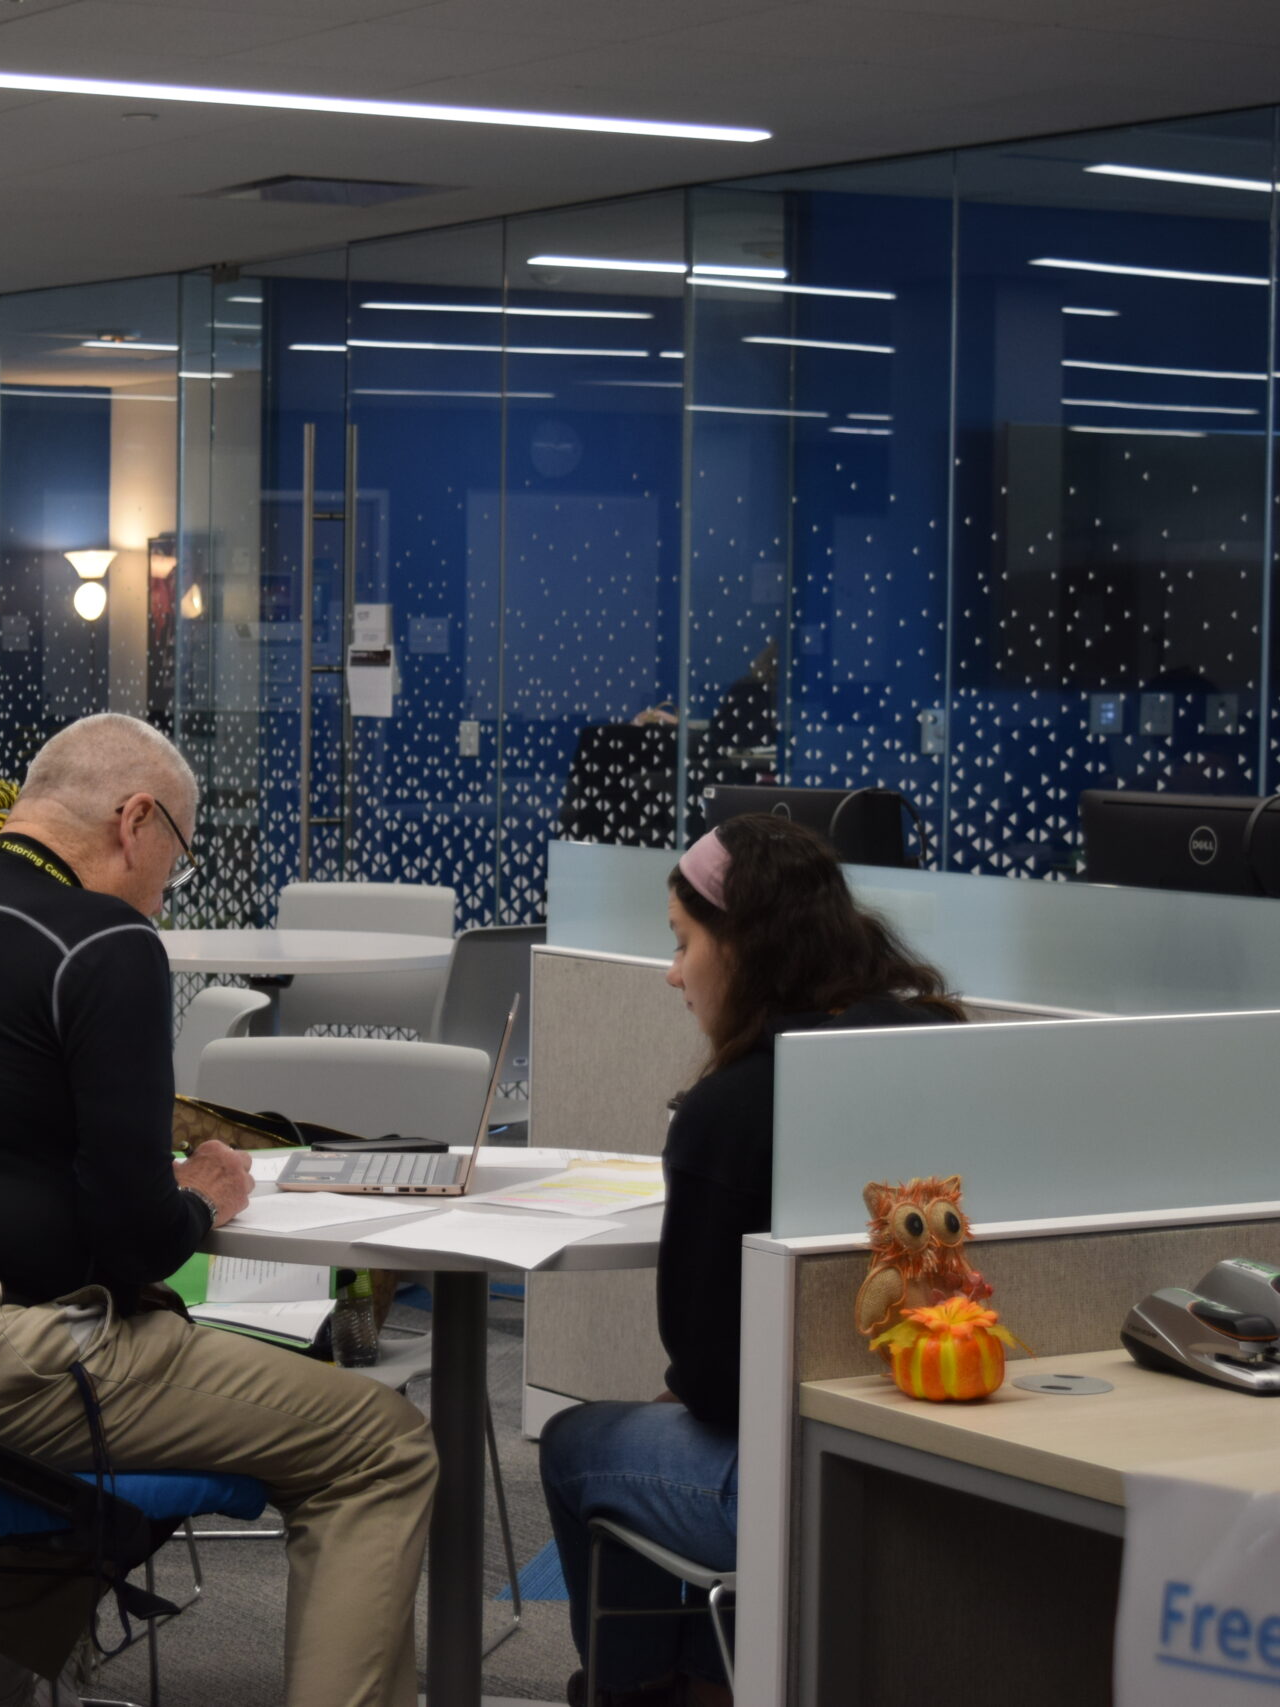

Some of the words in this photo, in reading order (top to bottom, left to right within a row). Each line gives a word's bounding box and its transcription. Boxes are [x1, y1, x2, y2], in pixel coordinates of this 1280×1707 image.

[1, 840, 44, 867] Tutoring
[1192, 839, 1214, 851] DELL
[1161, 1580, 1280, 1669] Free
